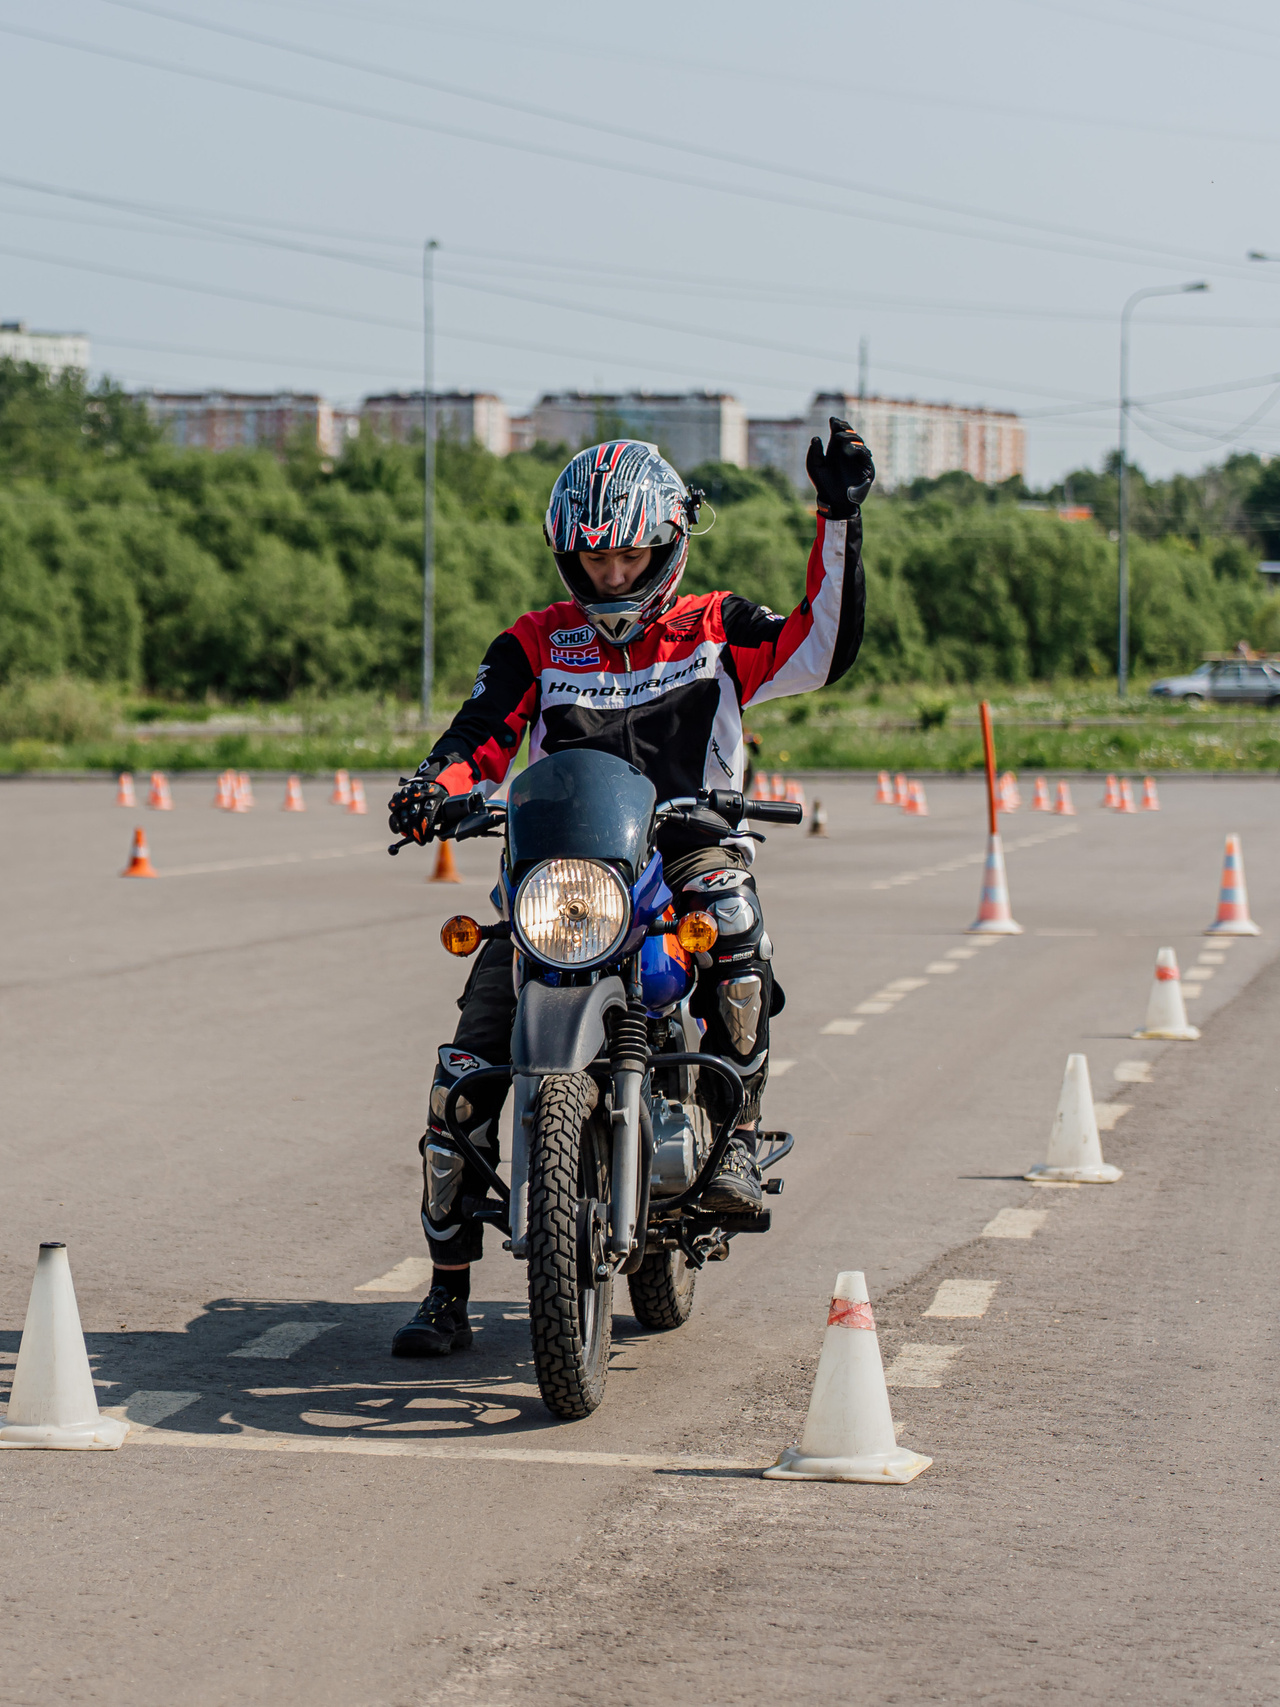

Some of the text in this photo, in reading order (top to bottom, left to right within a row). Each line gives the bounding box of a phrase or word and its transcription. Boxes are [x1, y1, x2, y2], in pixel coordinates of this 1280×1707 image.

[557, 629, 589, 644] SHOEI
[664, 631, 699, 642] HON
[550, 646, 600, 667] HRC
